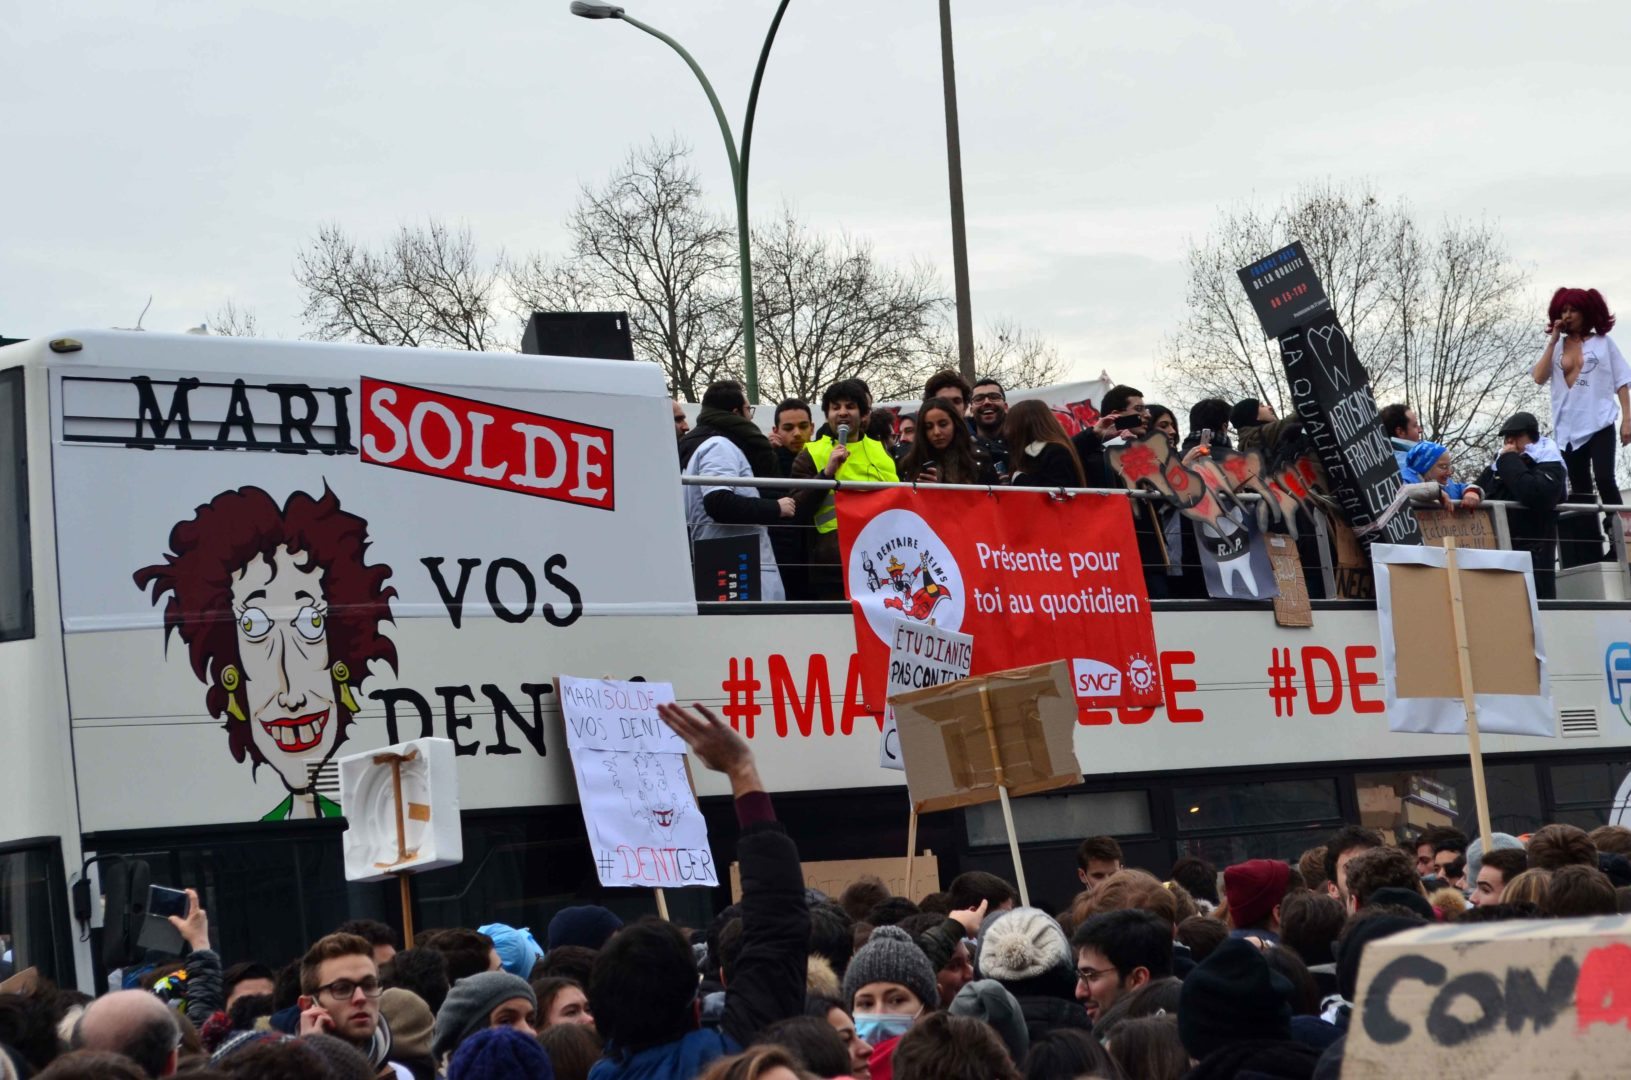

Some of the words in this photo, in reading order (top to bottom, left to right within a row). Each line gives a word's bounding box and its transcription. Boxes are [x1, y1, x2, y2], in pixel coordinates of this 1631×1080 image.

[1252, 279, 1264, 290] DE
[1263, 273, 1275, 284] LA
[1280, 333, 1304, 367] LA
[1329, 383, 1379, 447] ARTISANS
[1343, 424, 1394, 478] FRANÇAIS
[1386, 506, 1418, 543] NOUS
[876, 536, 919, 561] DENTAIRE
[924, 549, 948, 583] REIMS
[975, 542, 1063, 572] Présente
[1069, 551, 1120, 578] pour
[420, 553, 584, 630] VOS
[728, 573, 737, 599] FRA
[974, 586, 1003, 613] toi
[1009, 594, 1034, 614] au
[1039, 586, 1139, 621] quotidien
[896, 625, 972, 670] ÉTUDIANTS
[891, 660, 911, 686] PAS
[913, 665, 970, 688] CONTE
[1079, 673, 1118, 691] SNCF
[1267, 645, 1386, 718] #DE
[721, 653, 883, 739] #MA
[368, 683, 554, 757] DEN
[570, 716, 607, 739] VOS
[619, 717, 679, 740] DENT
